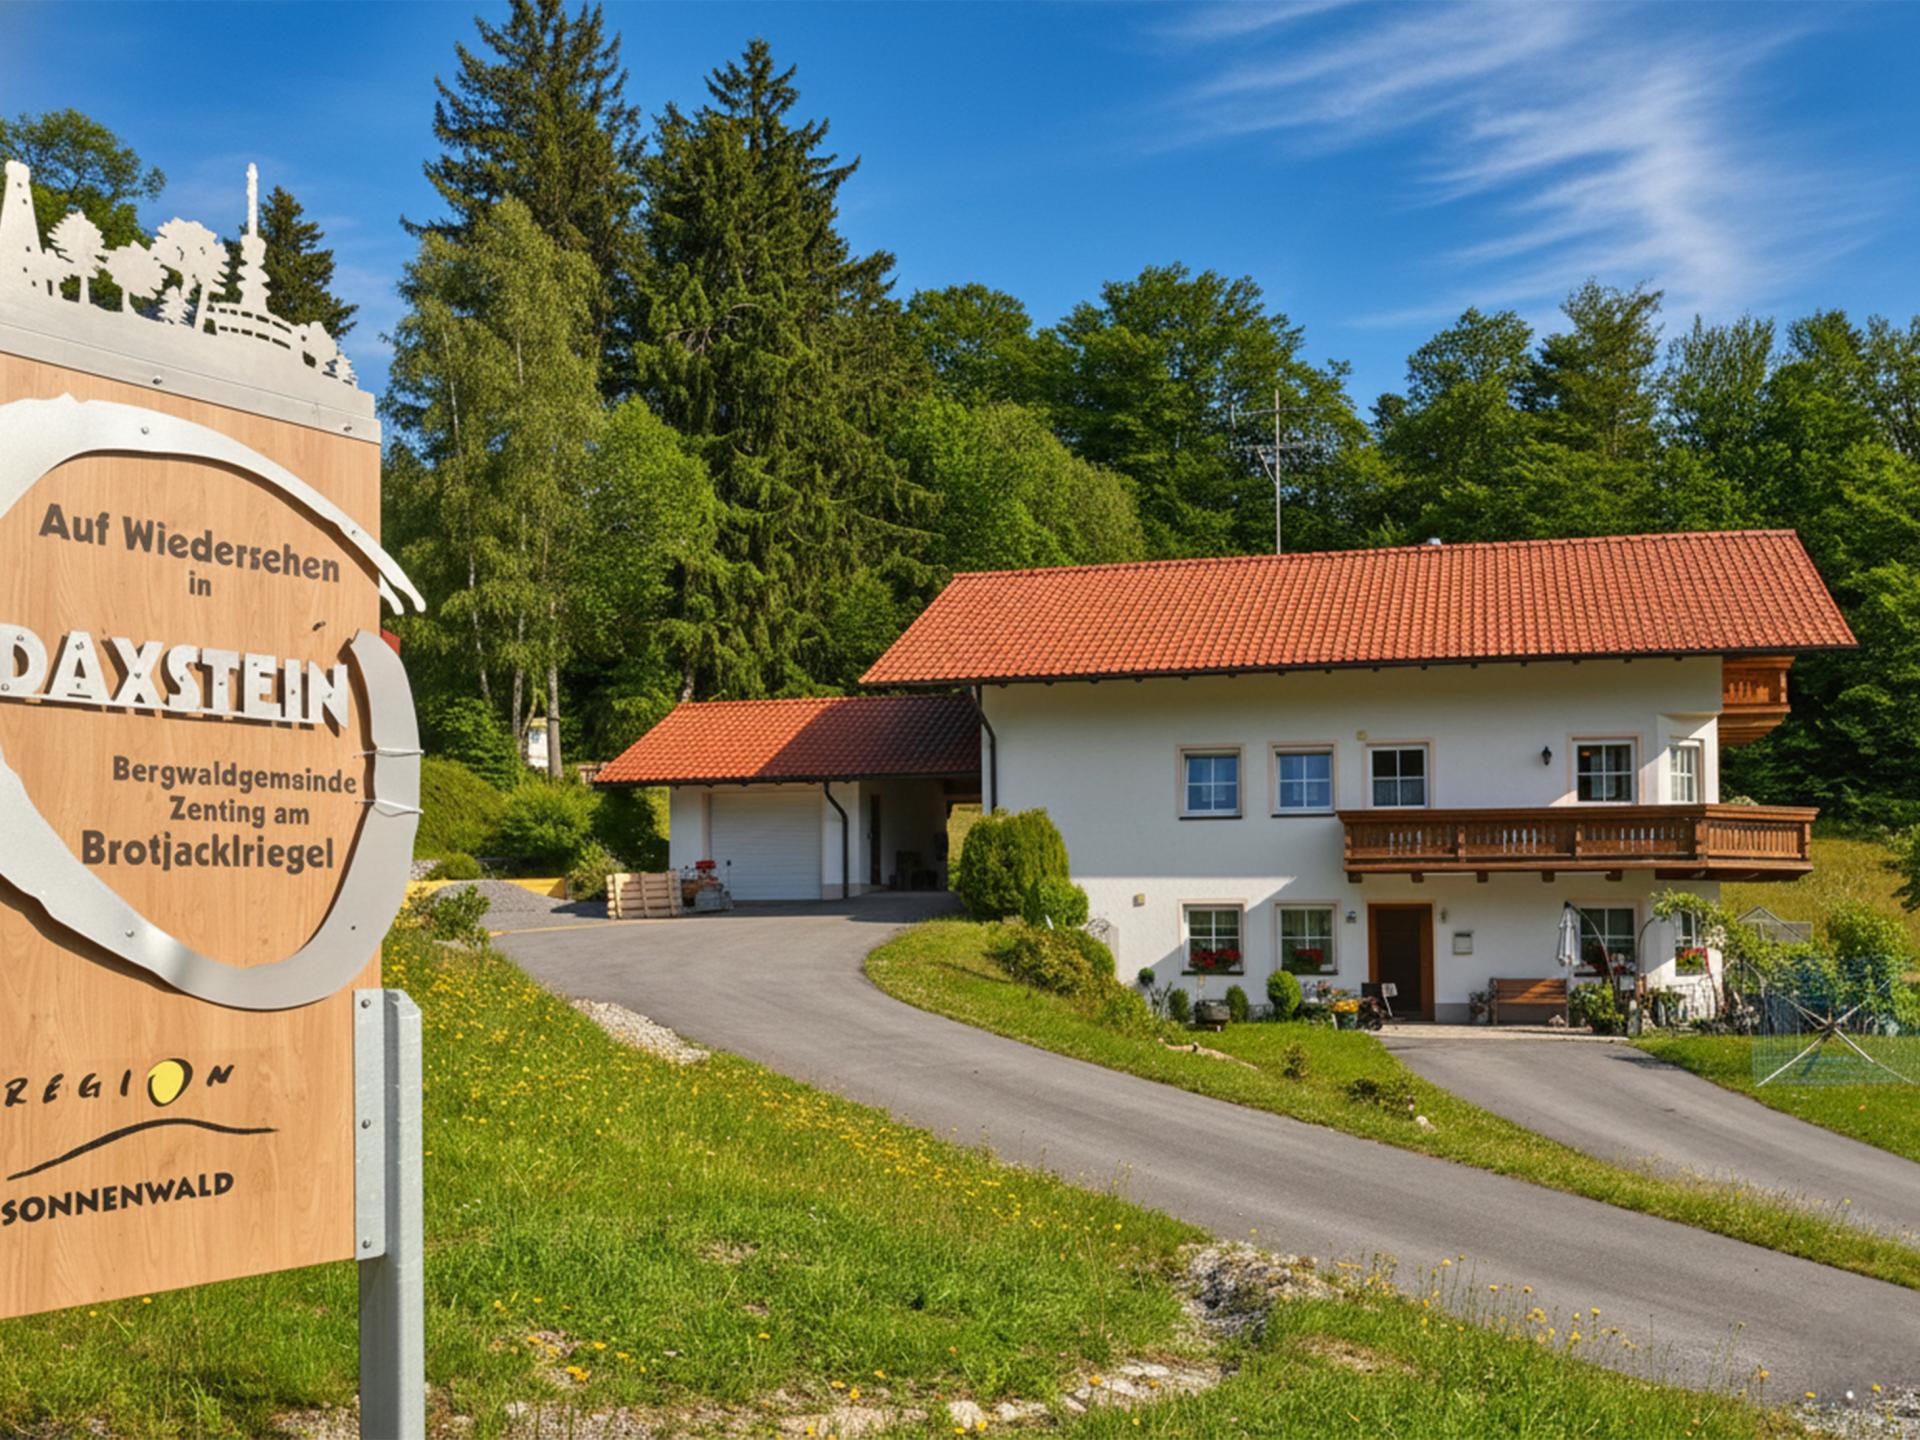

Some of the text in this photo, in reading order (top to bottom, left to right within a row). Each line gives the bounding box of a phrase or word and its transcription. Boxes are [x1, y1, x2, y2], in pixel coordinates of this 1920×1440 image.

[39, 503, 109, 545] Auf
[189, 570, 212, 597] in
[0, 623, 348, 729] DAXSTEIN
[169, 795, 309, 828] Zenting am
[82, 829, 333, 874] Brotjacklriegel
[4, 1057, 235, 1108] REGION
[1, 1172, 234, 1226] SONNENWALD
